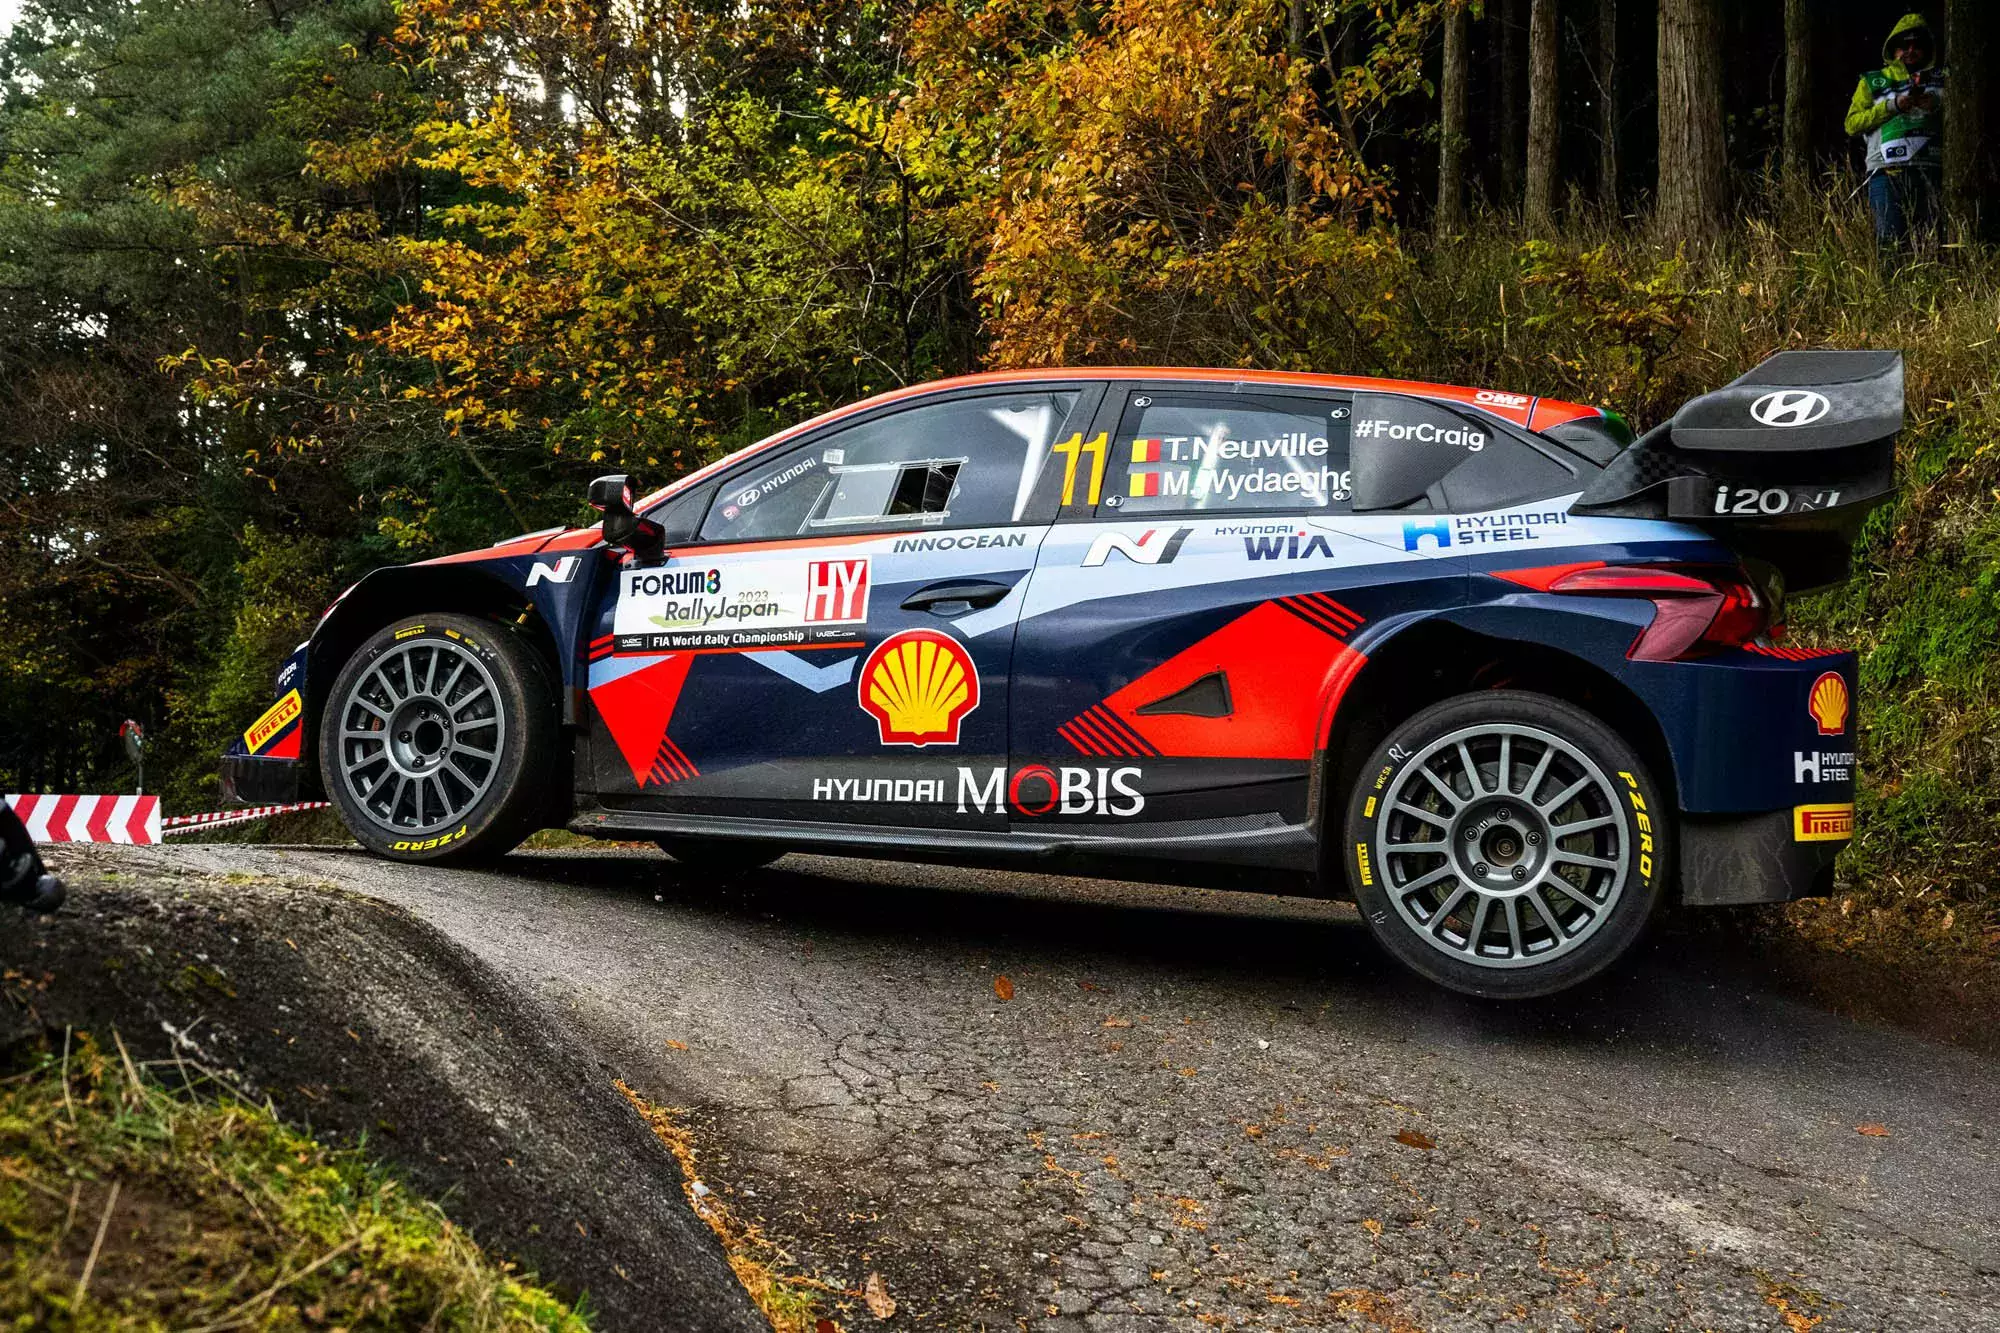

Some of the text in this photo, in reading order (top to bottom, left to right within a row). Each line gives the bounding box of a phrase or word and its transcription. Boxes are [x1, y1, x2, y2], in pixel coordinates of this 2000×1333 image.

[1475, 391, 1528, 406] OMP
[1355, 420, 1485, 451] #ForCraig
[761, 457, 817, 493] HYUNDAI
[1053, 432, 1108, 506] 11
[1215, 525, 1294, 535] HYUNDAI
[1456, 511, 1568, 529] HYUNDAI
[893, 533, 1026, 553] INNOCEAN
[1458, 528, 1539, 544] STEEL
[738, 590, 769, 603] 2023
[804, 560, 867, 622] HY
[653, 630, 805, 647] FIA World Rally Championship
[249, 697, 298, 747] PIRELLI
[1821, 768, 1850, 781] STEEL
[813, 778, 944, 802] HYUNDAI
[956, 765, 1145, 817] MOBIS
